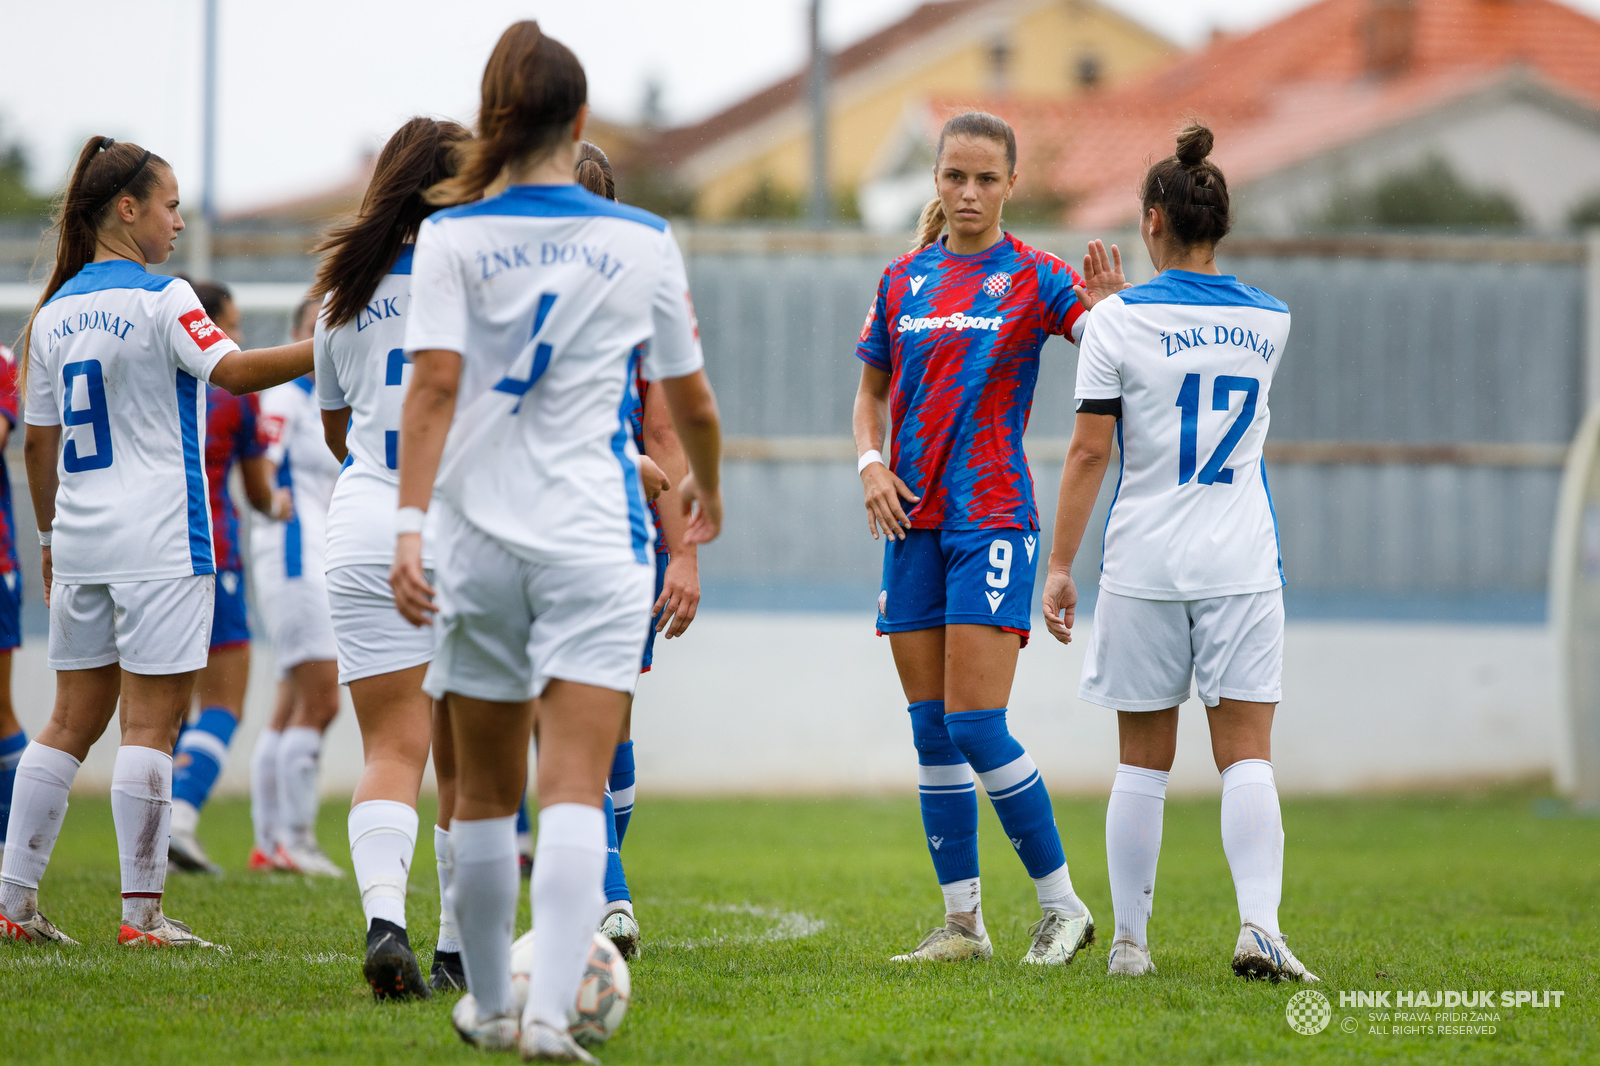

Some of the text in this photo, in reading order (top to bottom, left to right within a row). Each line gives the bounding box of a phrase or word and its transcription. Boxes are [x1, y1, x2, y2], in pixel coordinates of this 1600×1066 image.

[475, 242, 623, 281] ŽNK DONAT
[78, 310, 135, 341] DONAT
[897, 312, 1003, 333] SuperSport
[1159, 325, 1275, 364] ŽNK DONAT
[63, 359, 113, 473] 9
[1175, 373, 1260, 486] 12
[986, 539, 1013, 589] 9
